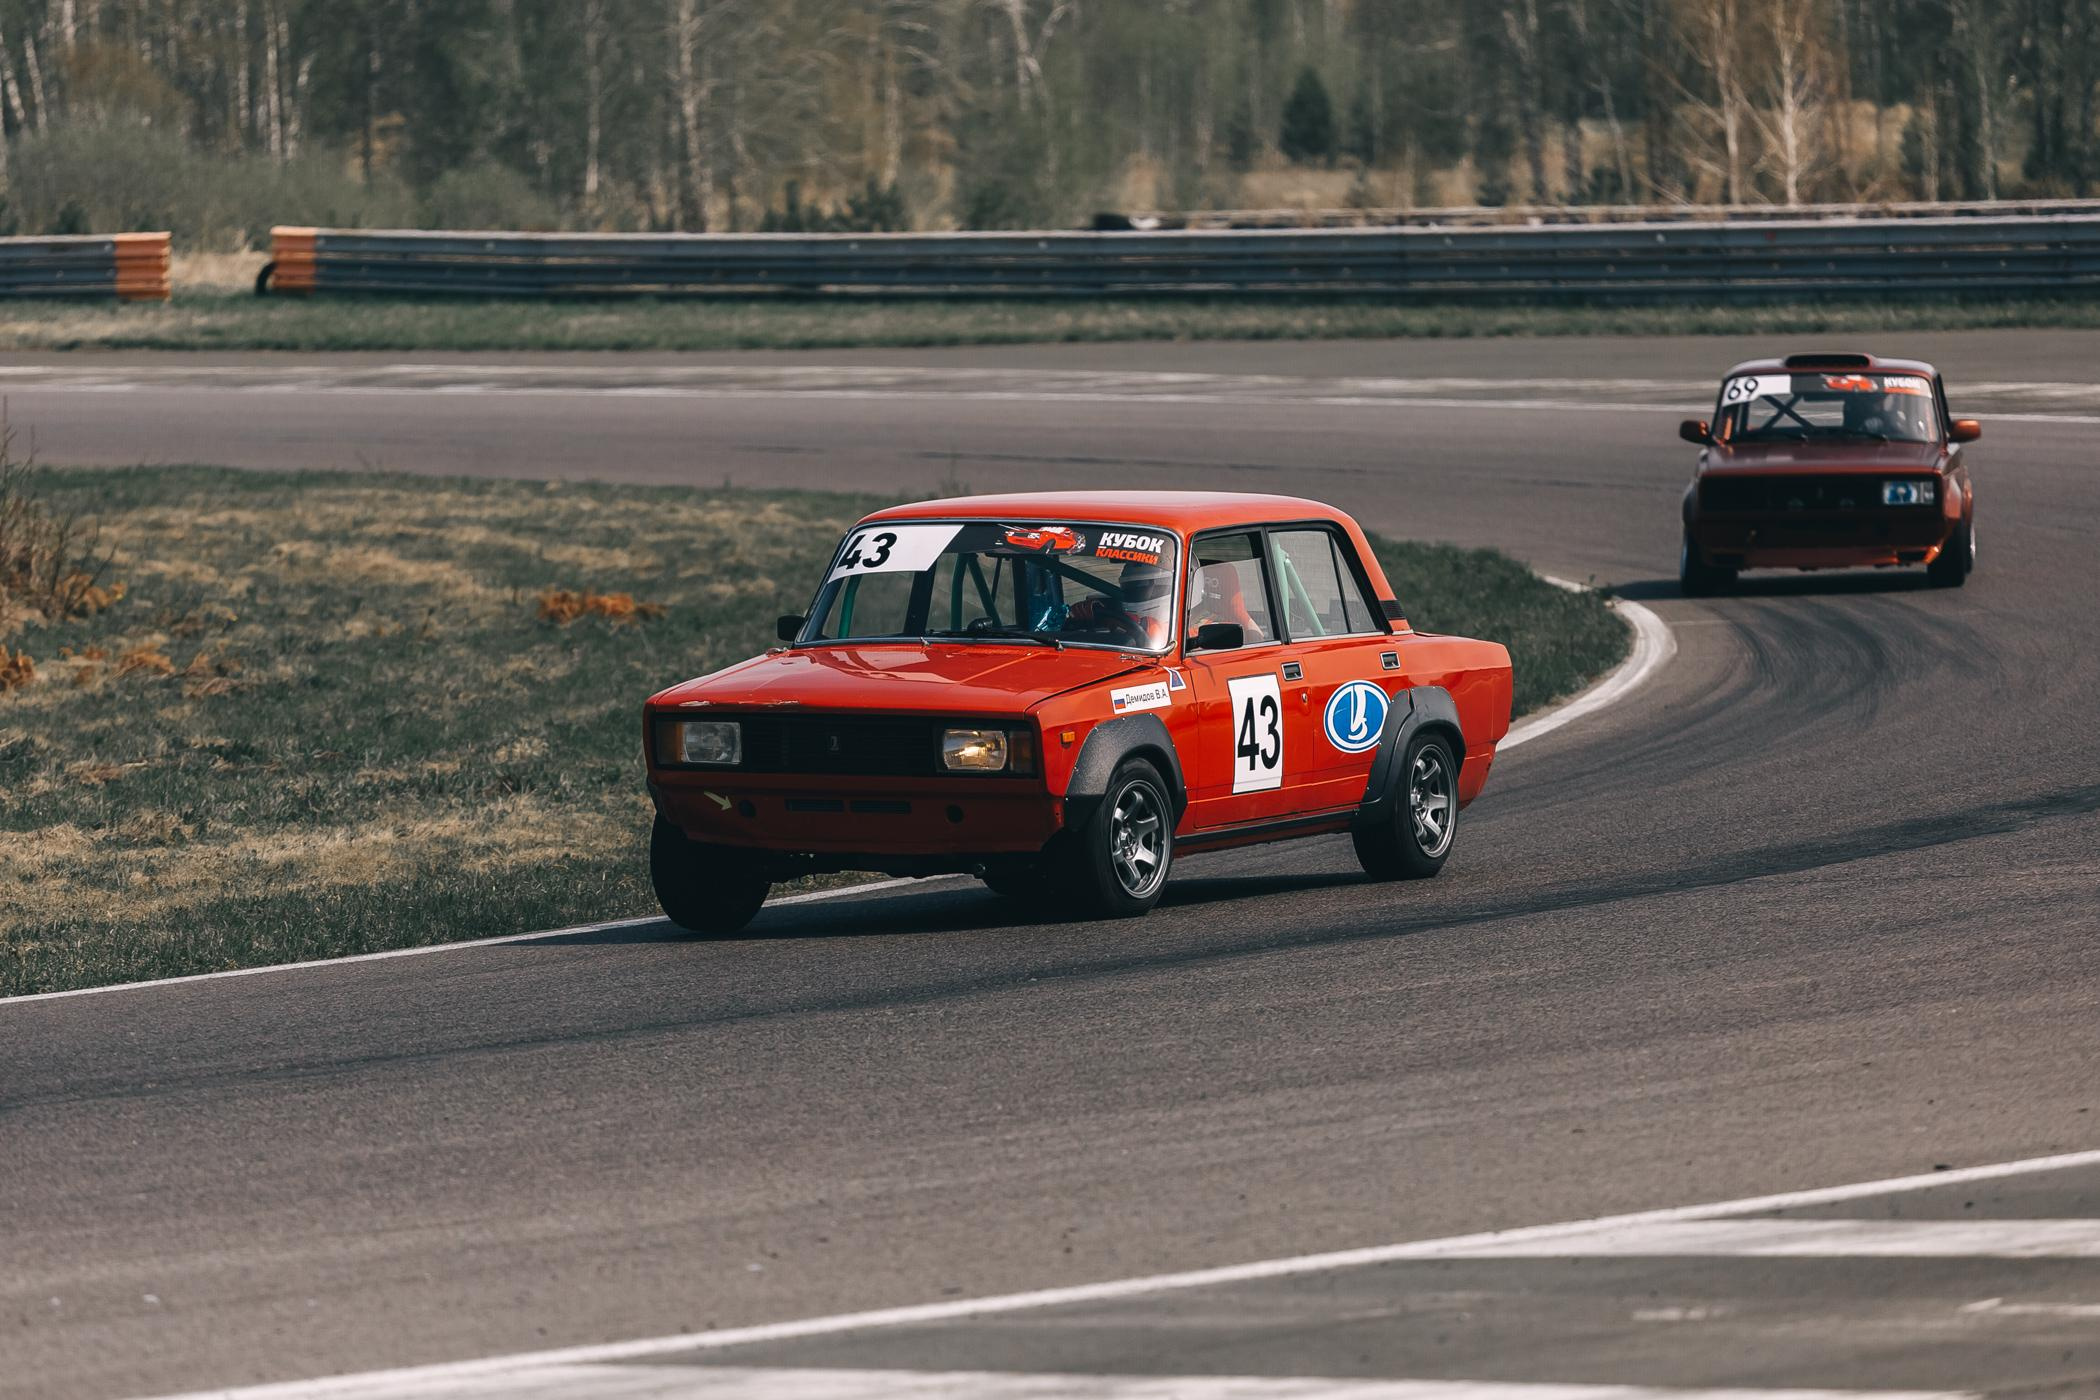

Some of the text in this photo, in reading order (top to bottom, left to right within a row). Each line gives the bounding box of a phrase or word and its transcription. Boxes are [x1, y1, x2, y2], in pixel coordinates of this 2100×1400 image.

[1728, 378, 1758, 400] 69
[837, 532, 897, 569] 43
[1099, 532, 1164, 553] КУБОК
[1096, 547, 1159, 565] КЛАССИКИ
[1126, 692, 1155, 705] Демидов
[1237, 695, 1280, 771] 43
